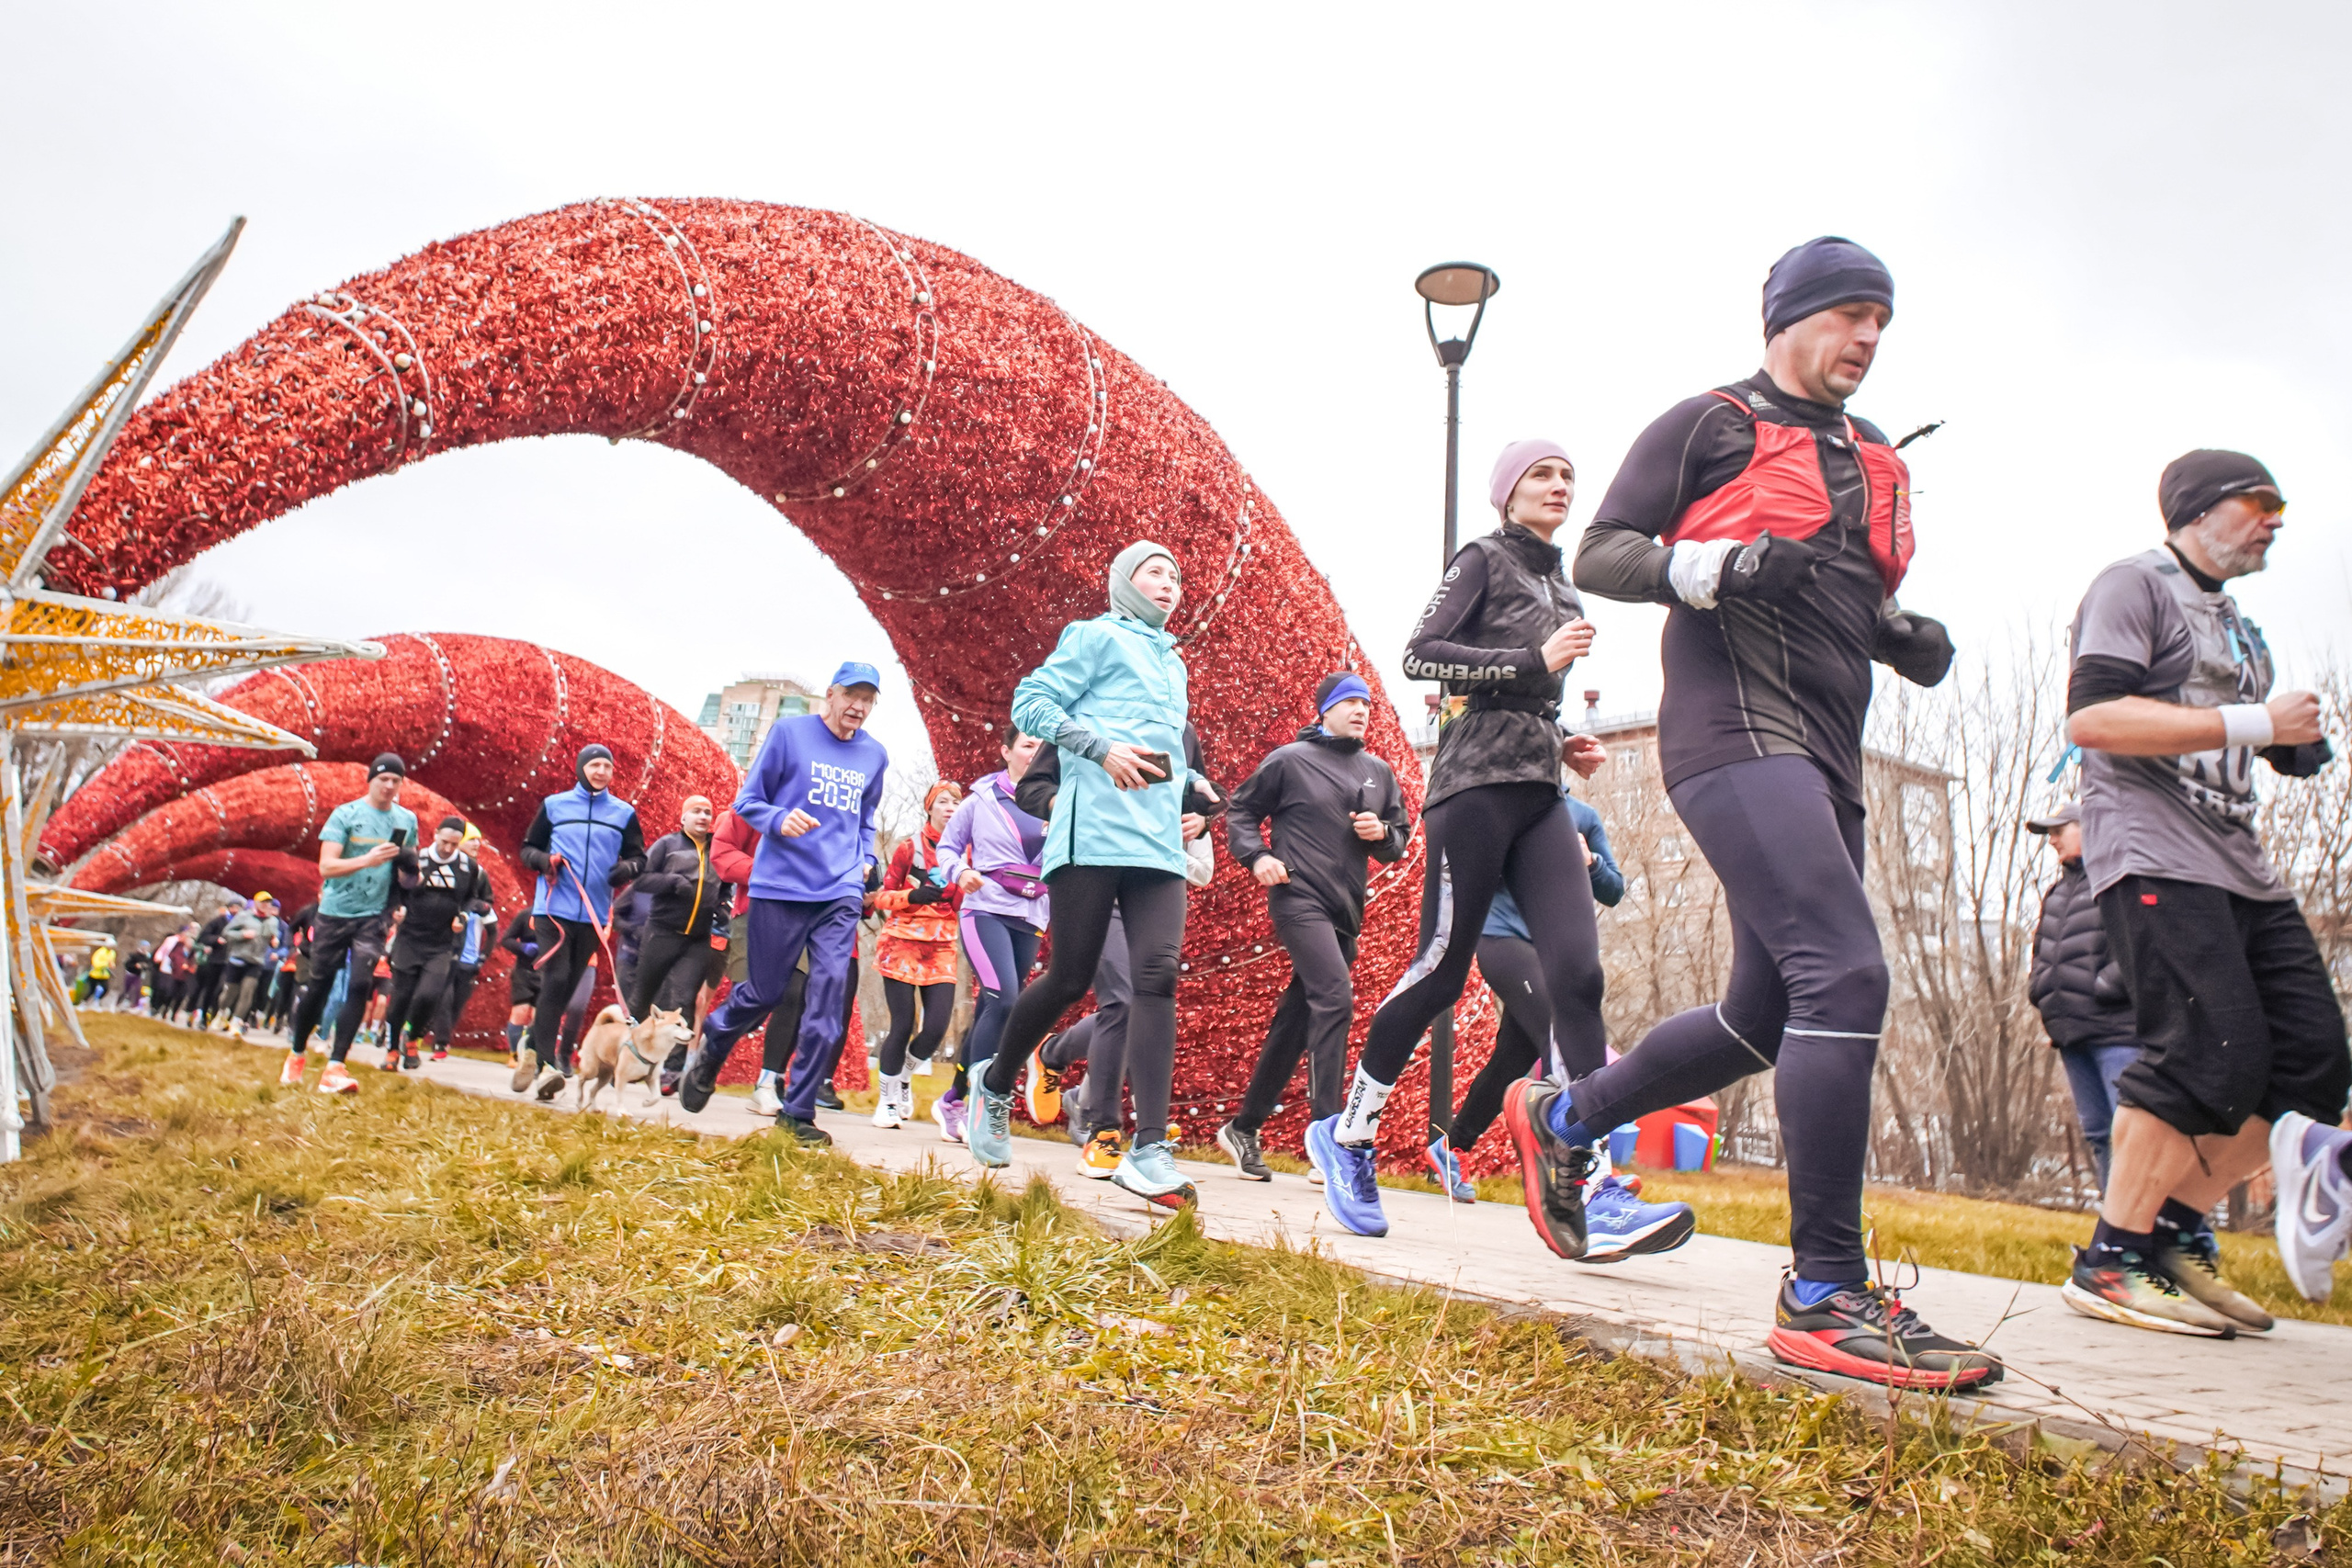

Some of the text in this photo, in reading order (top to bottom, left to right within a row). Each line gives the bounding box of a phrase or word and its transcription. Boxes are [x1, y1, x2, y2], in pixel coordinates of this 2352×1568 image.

[811, 761, 865, 788] МОСКВА
[808, 777, 862, 815] 2030
[1344, 1076, 1368, 1129] DAGESTAN
